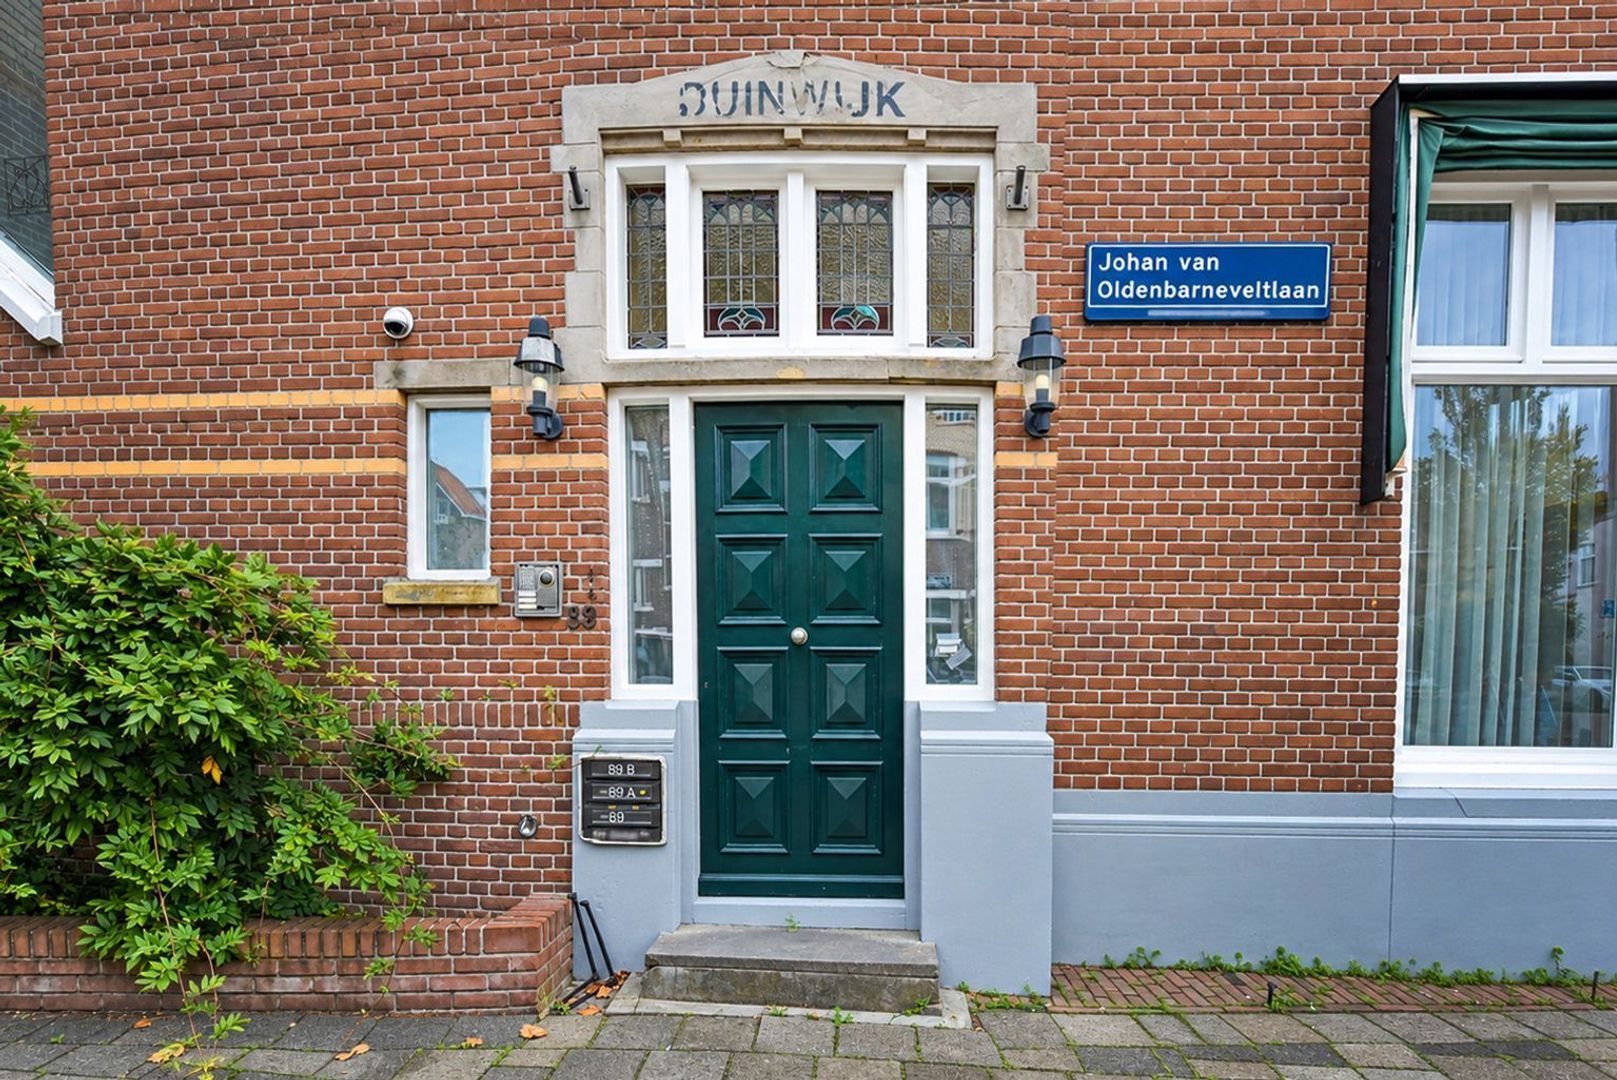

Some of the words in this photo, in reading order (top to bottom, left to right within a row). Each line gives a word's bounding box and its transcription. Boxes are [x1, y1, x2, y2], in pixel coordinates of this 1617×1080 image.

[1098, 252, 1168, 271] Johan
[1179, 256, 1220, 271] van
[1097, 280, 1320, 299] Oldenbarneveltlaan
[608, 764, 623, 775] 89
[627, 764, 635, 775] B
[608, 786, 624, 798] 89
[627, 787, 636, 798] A
[609, 811, 624, 823] 89
